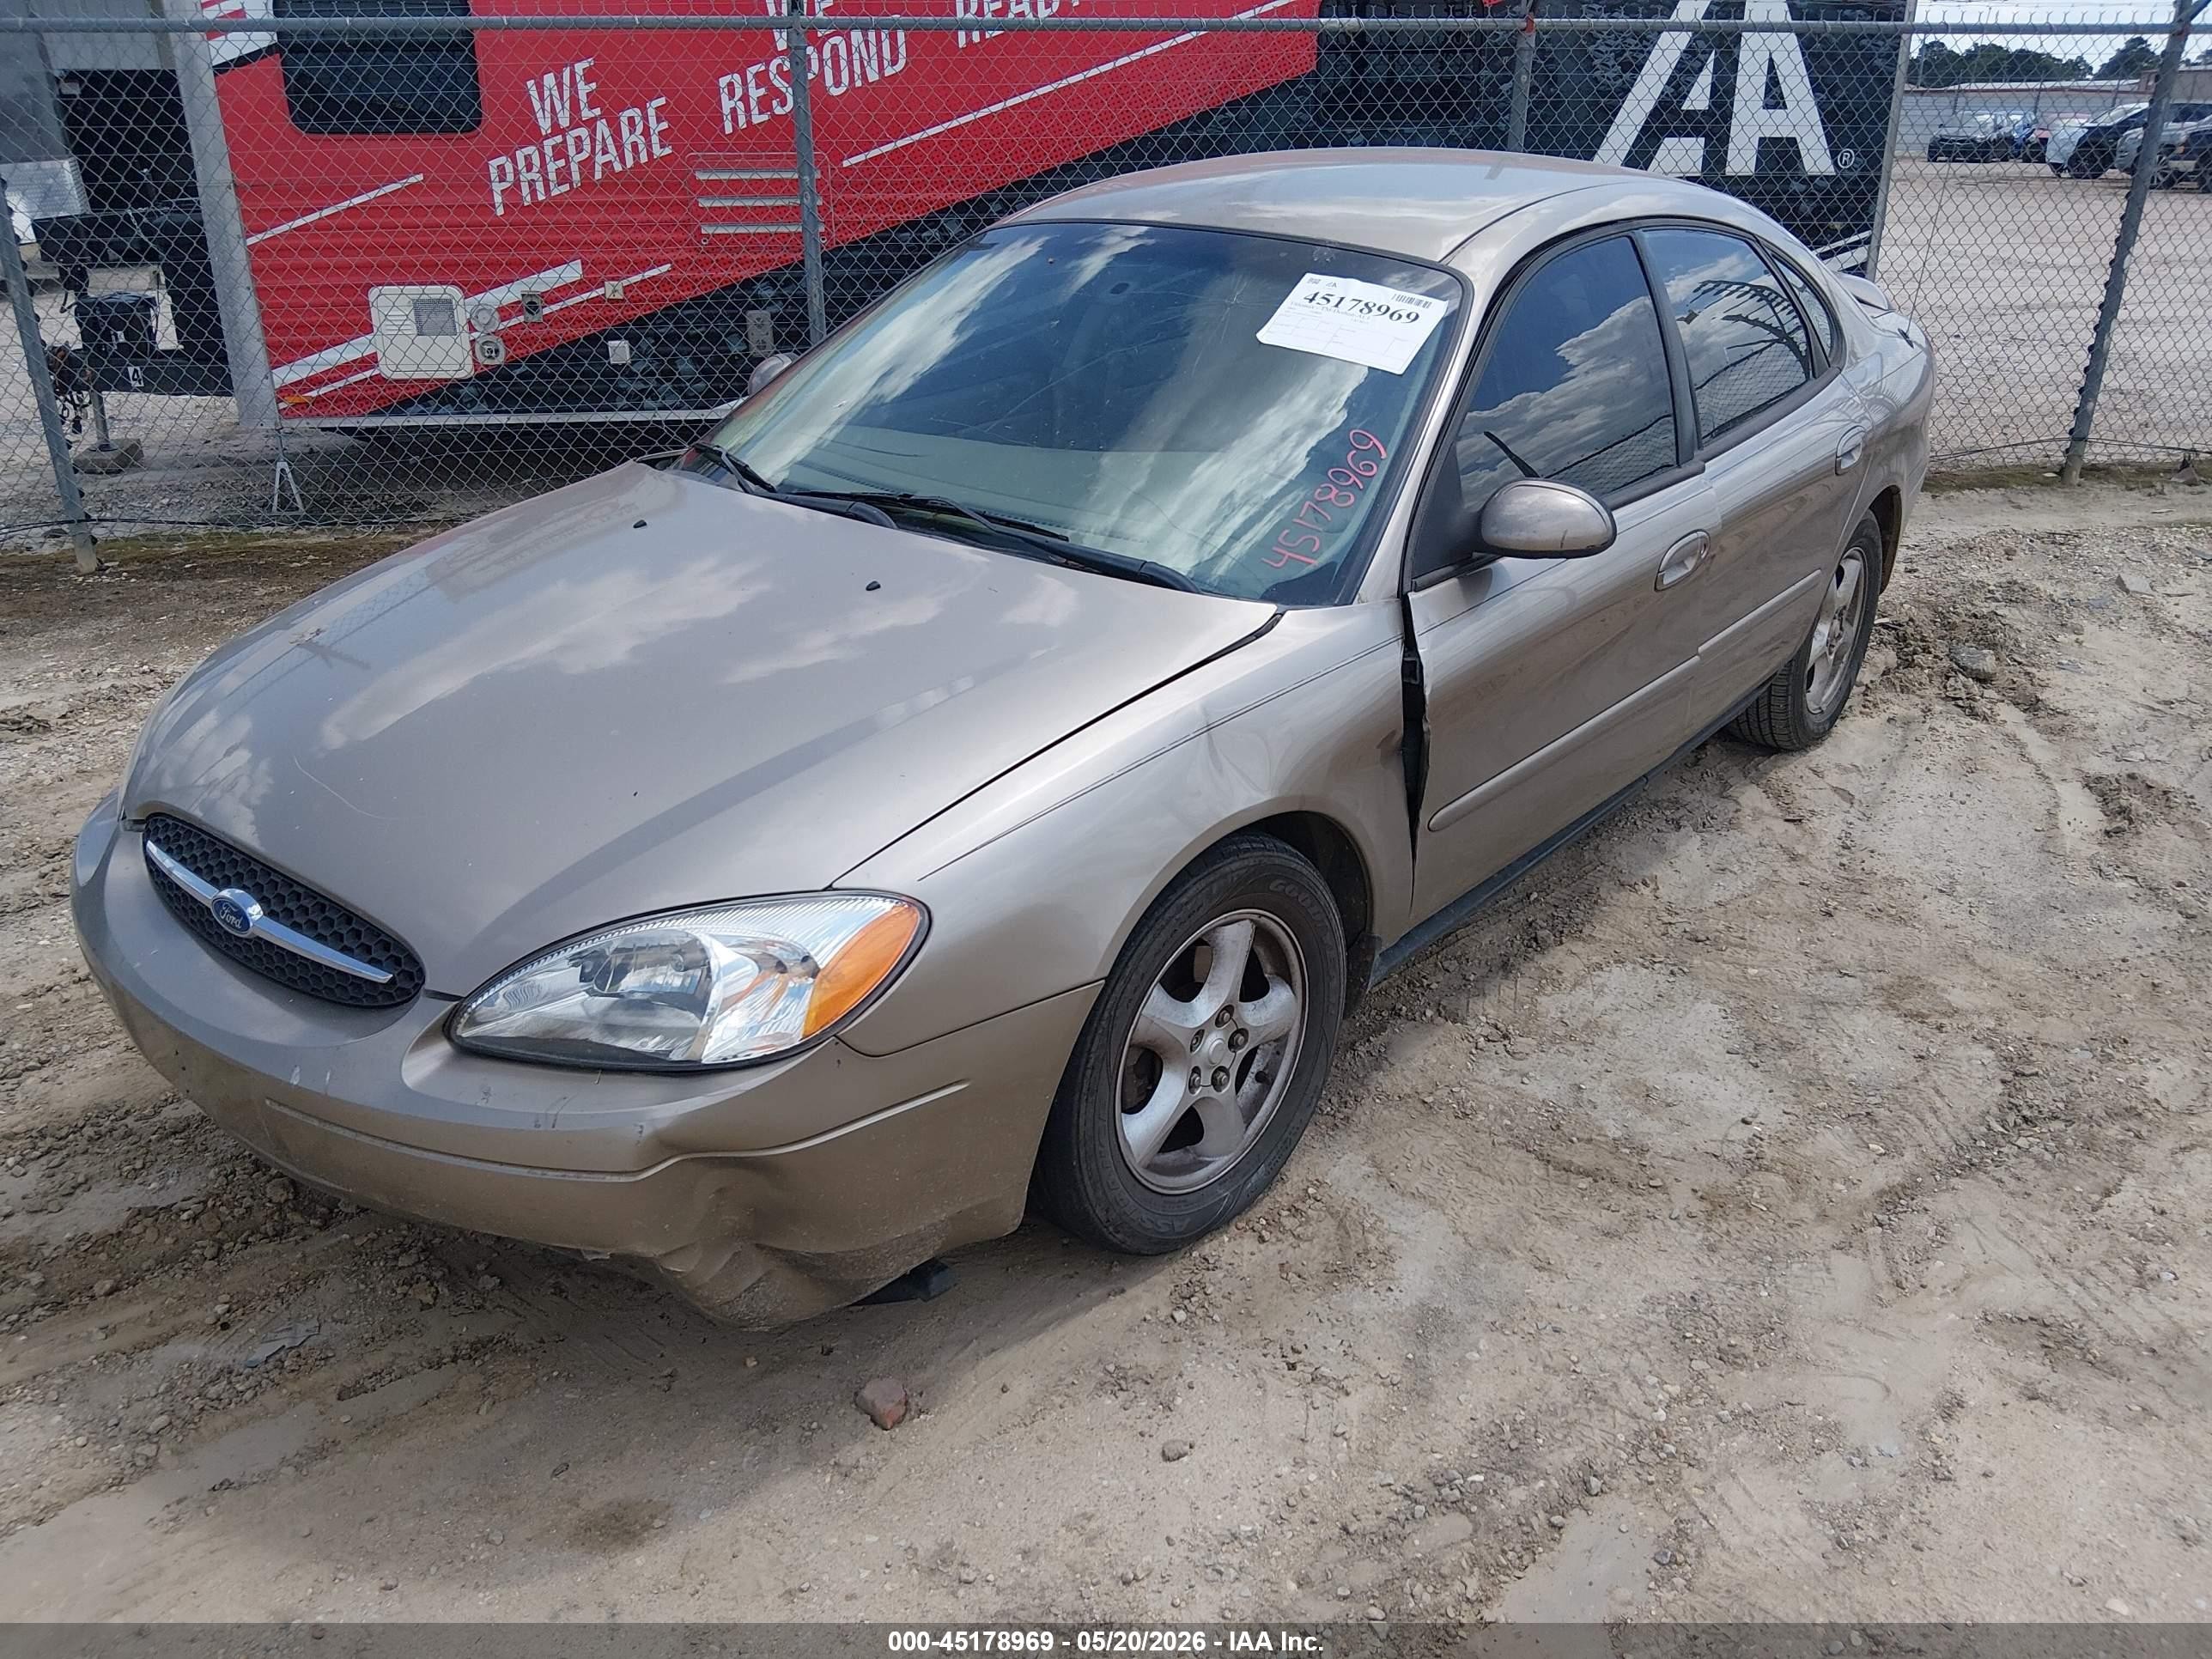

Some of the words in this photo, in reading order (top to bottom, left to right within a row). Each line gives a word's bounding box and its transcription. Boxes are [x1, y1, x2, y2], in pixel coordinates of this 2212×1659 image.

[526, 58, 601, 136] WE
[488, 96, 673, 216] PREPARE
[1304, 291, 1420, 324] 45178969
[1261, 429, 1387, 568] 45178969
[221, 902, 241, 928] Ford
